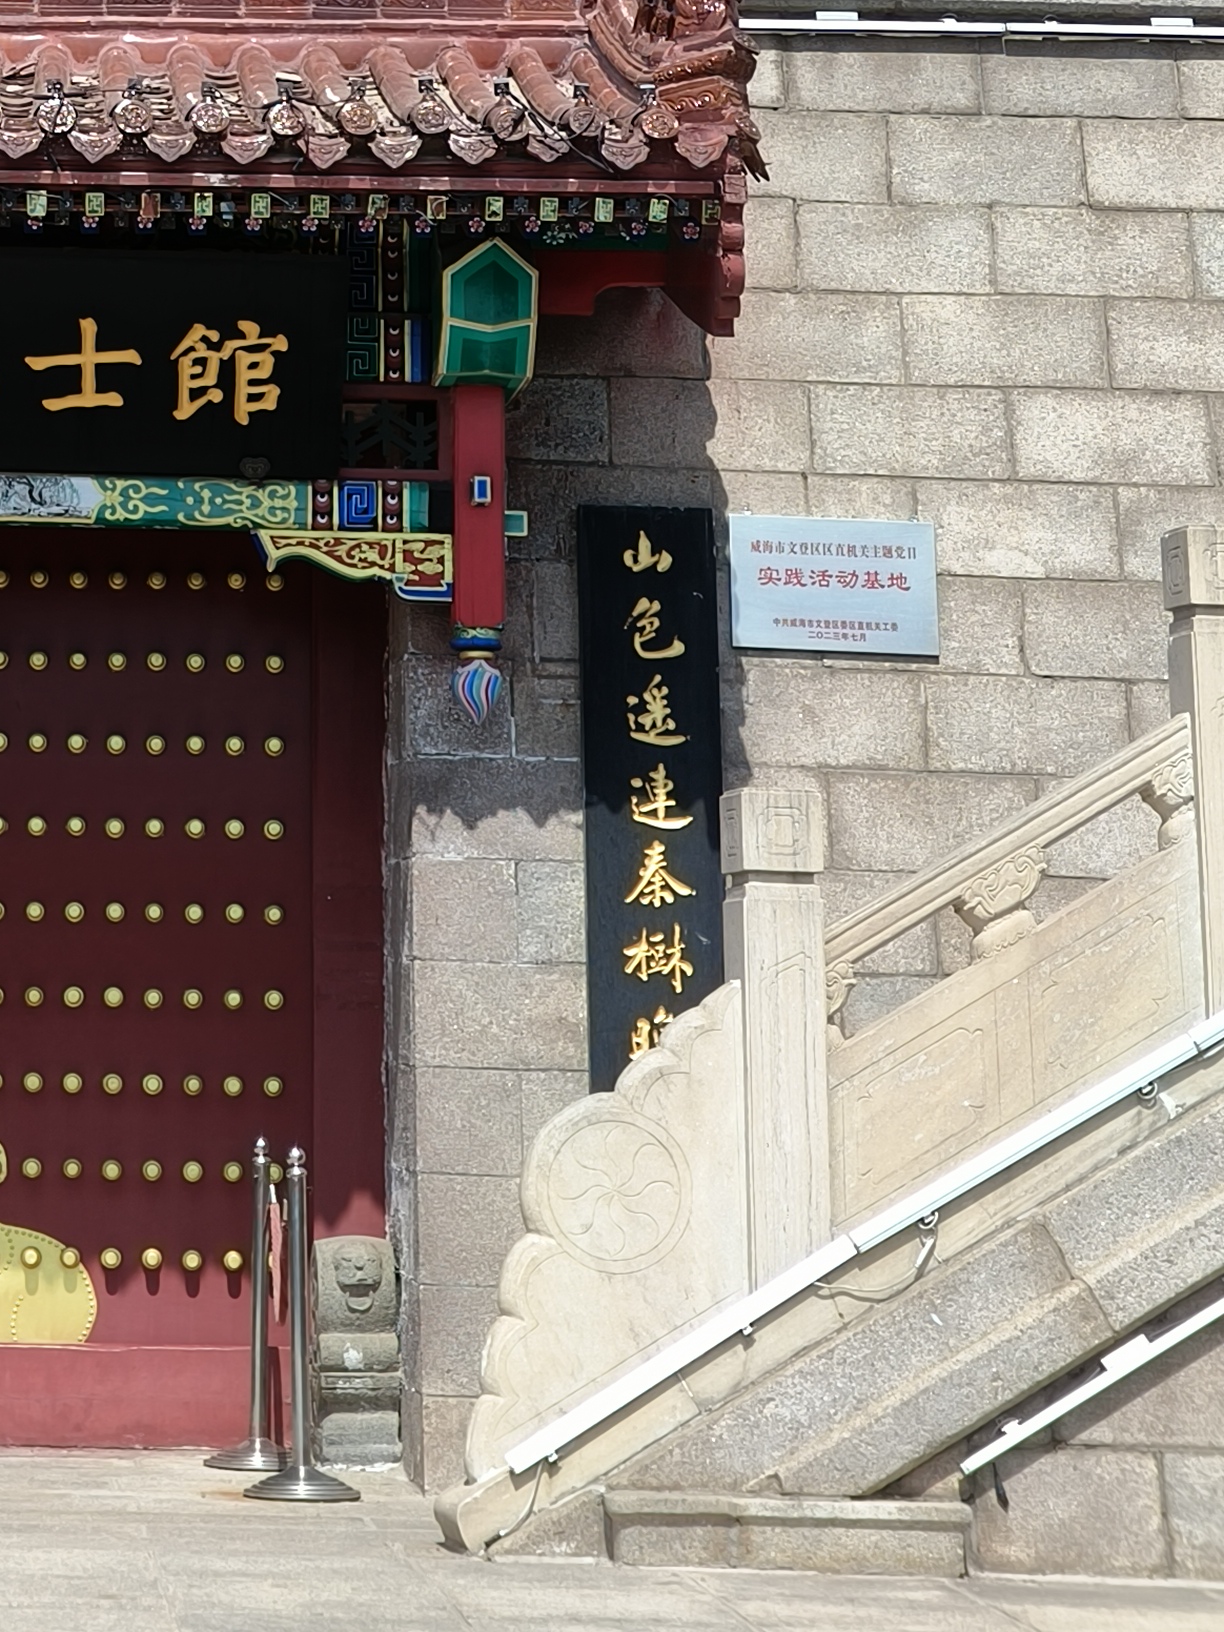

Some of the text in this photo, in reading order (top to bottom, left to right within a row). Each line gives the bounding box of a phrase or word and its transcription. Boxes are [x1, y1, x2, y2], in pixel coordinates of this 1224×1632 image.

[749, 538, 918, 561] 威海市文登区区直机关主题党日
[757, 566, 912, 592] 实践活动基地
